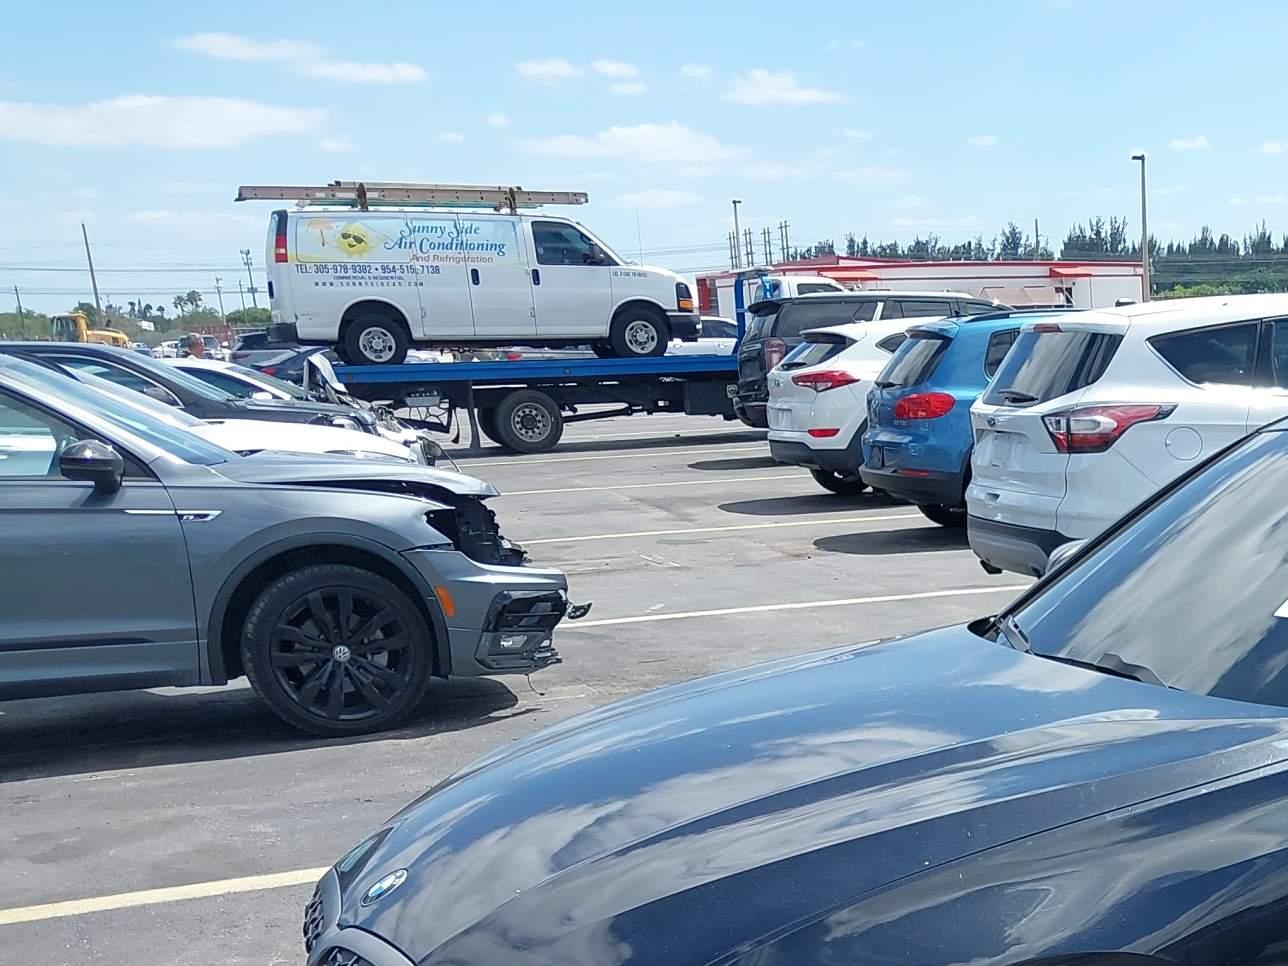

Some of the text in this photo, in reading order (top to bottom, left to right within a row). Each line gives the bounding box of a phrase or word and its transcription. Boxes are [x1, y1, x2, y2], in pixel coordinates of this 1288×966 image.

[399, 220, 480, 238] Sunny Side
[384, 236, 506, 256] Air Conditioning
[411, 254, 430, 262] And
[295, 264, 312, 274] TEL:
[313, 264, 372, 274] 305-978-9382
